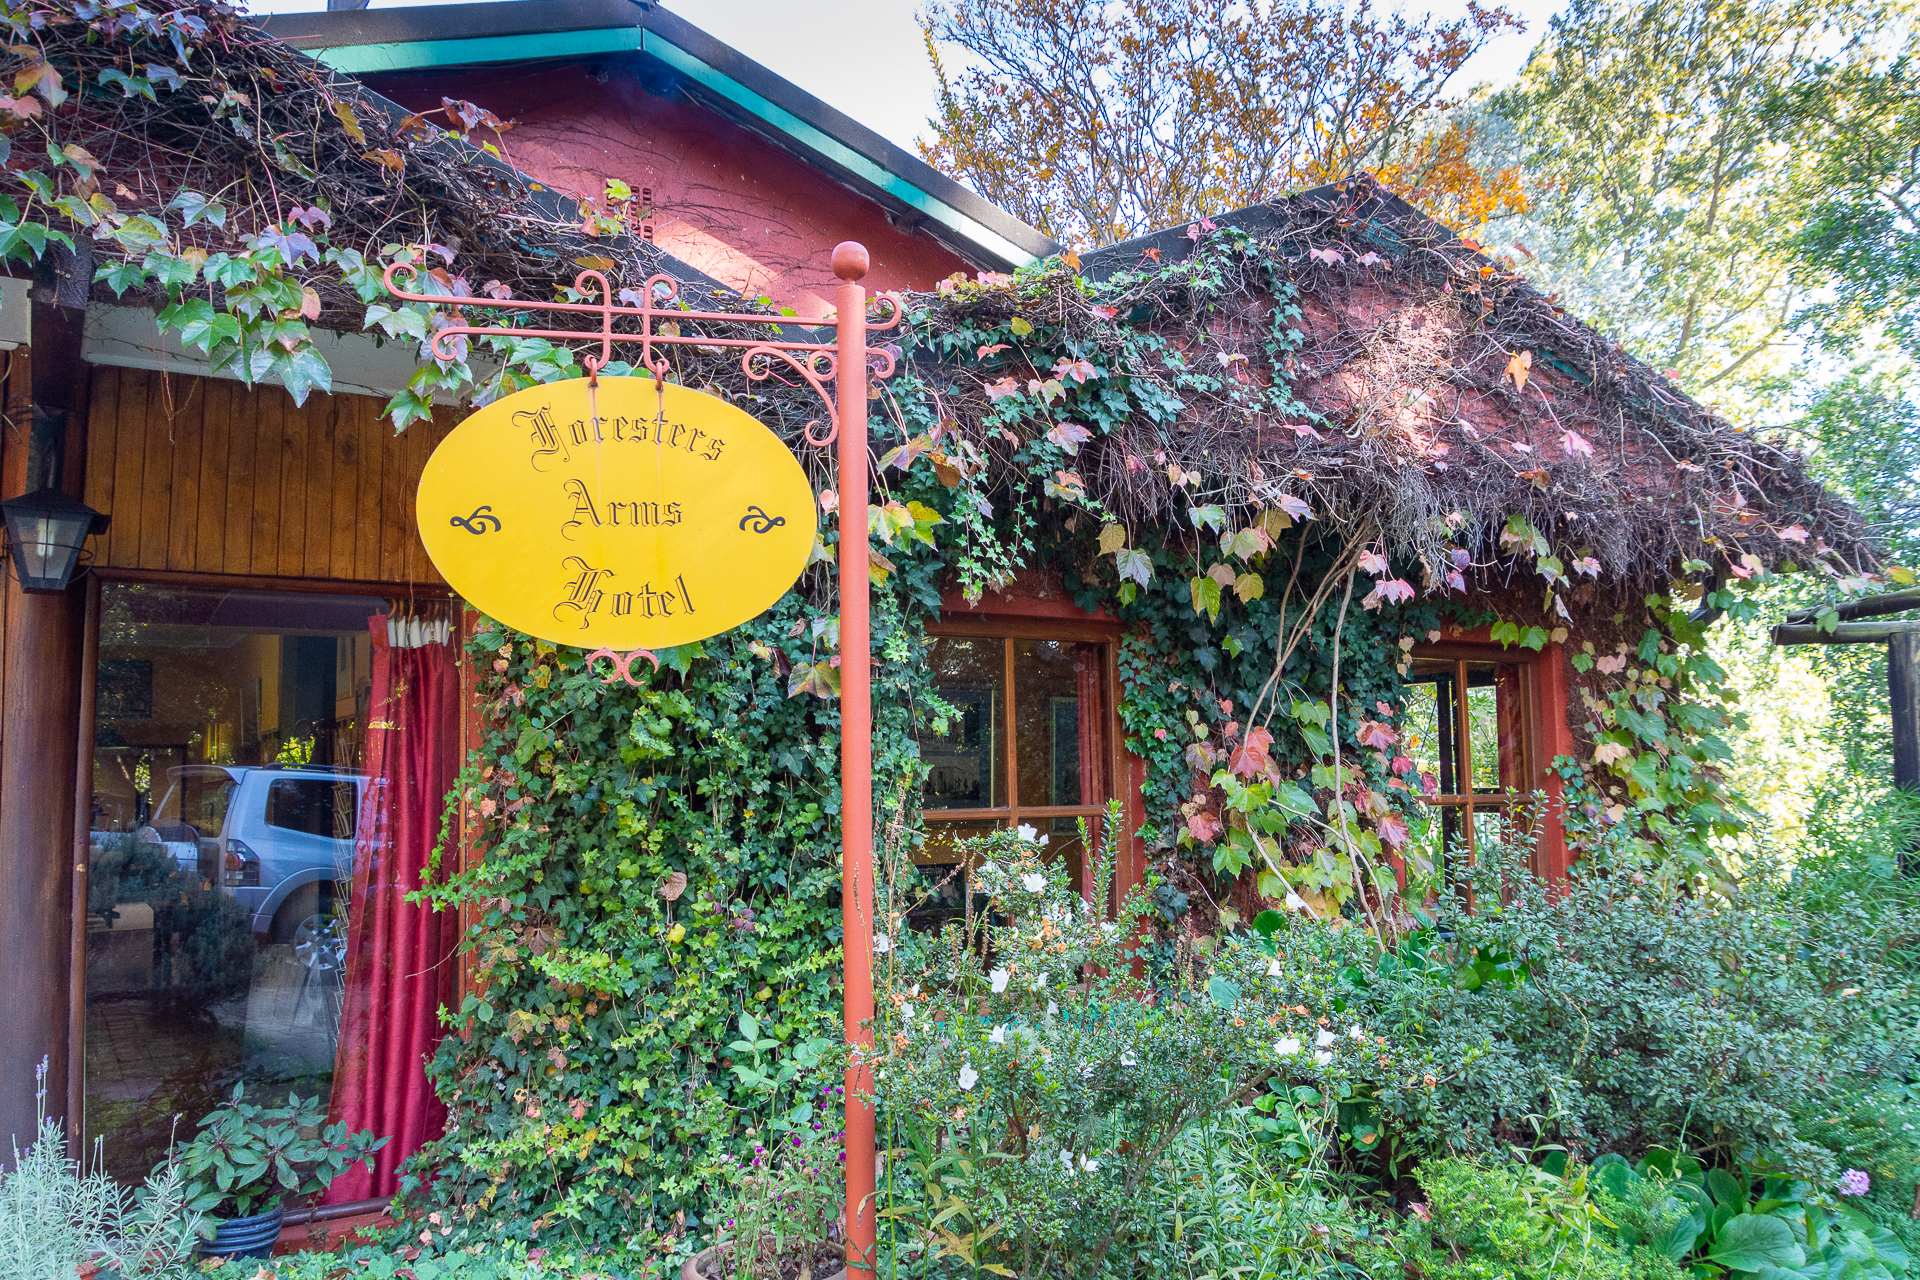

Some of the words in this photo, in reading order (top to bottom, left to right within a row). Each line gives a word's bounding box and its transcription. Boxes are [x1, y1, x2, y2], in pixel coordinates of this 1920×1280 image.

[512, 402, 726, 472] Foresters
[561, 479, 683, 541] Arms
[553, 556, 695, 629] Hotel
